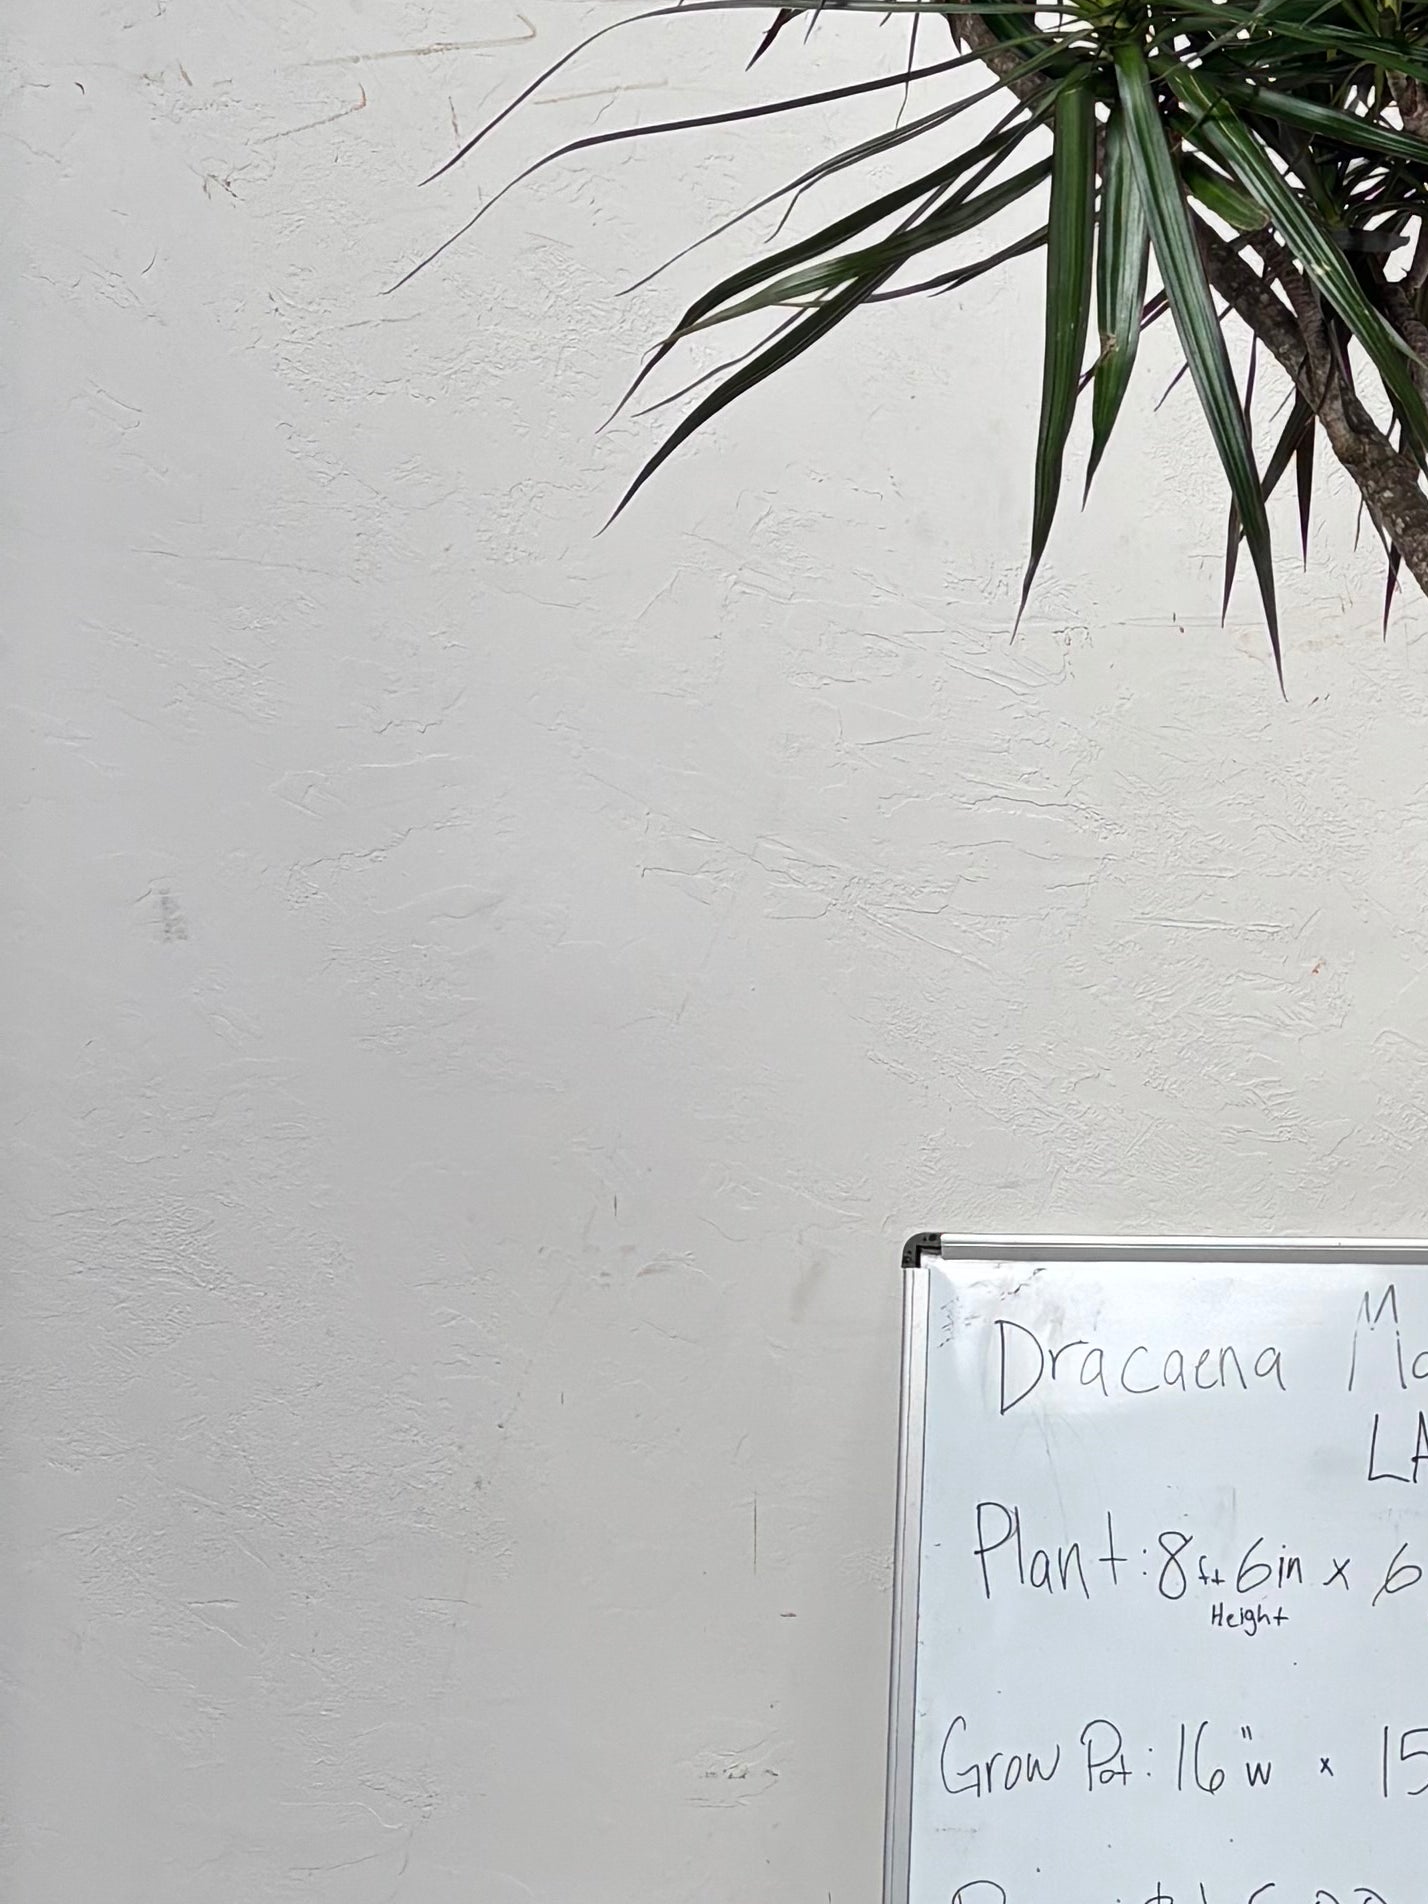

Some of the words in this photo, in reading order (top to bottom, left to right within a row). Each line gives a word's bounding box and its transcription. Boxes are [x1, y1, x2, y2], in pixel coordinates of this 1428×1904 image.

[995, 1319, 1287, 1416] Dracaena
[974, 1501, 1148, 1600] Plant:
[1322, 1557, 1351, 1591] x
[1210, 1601, 1290, 1637] Height
[940, 1714, 1061, 1798] Grow
[1080, 1718, 1155, 1793] Pot:
